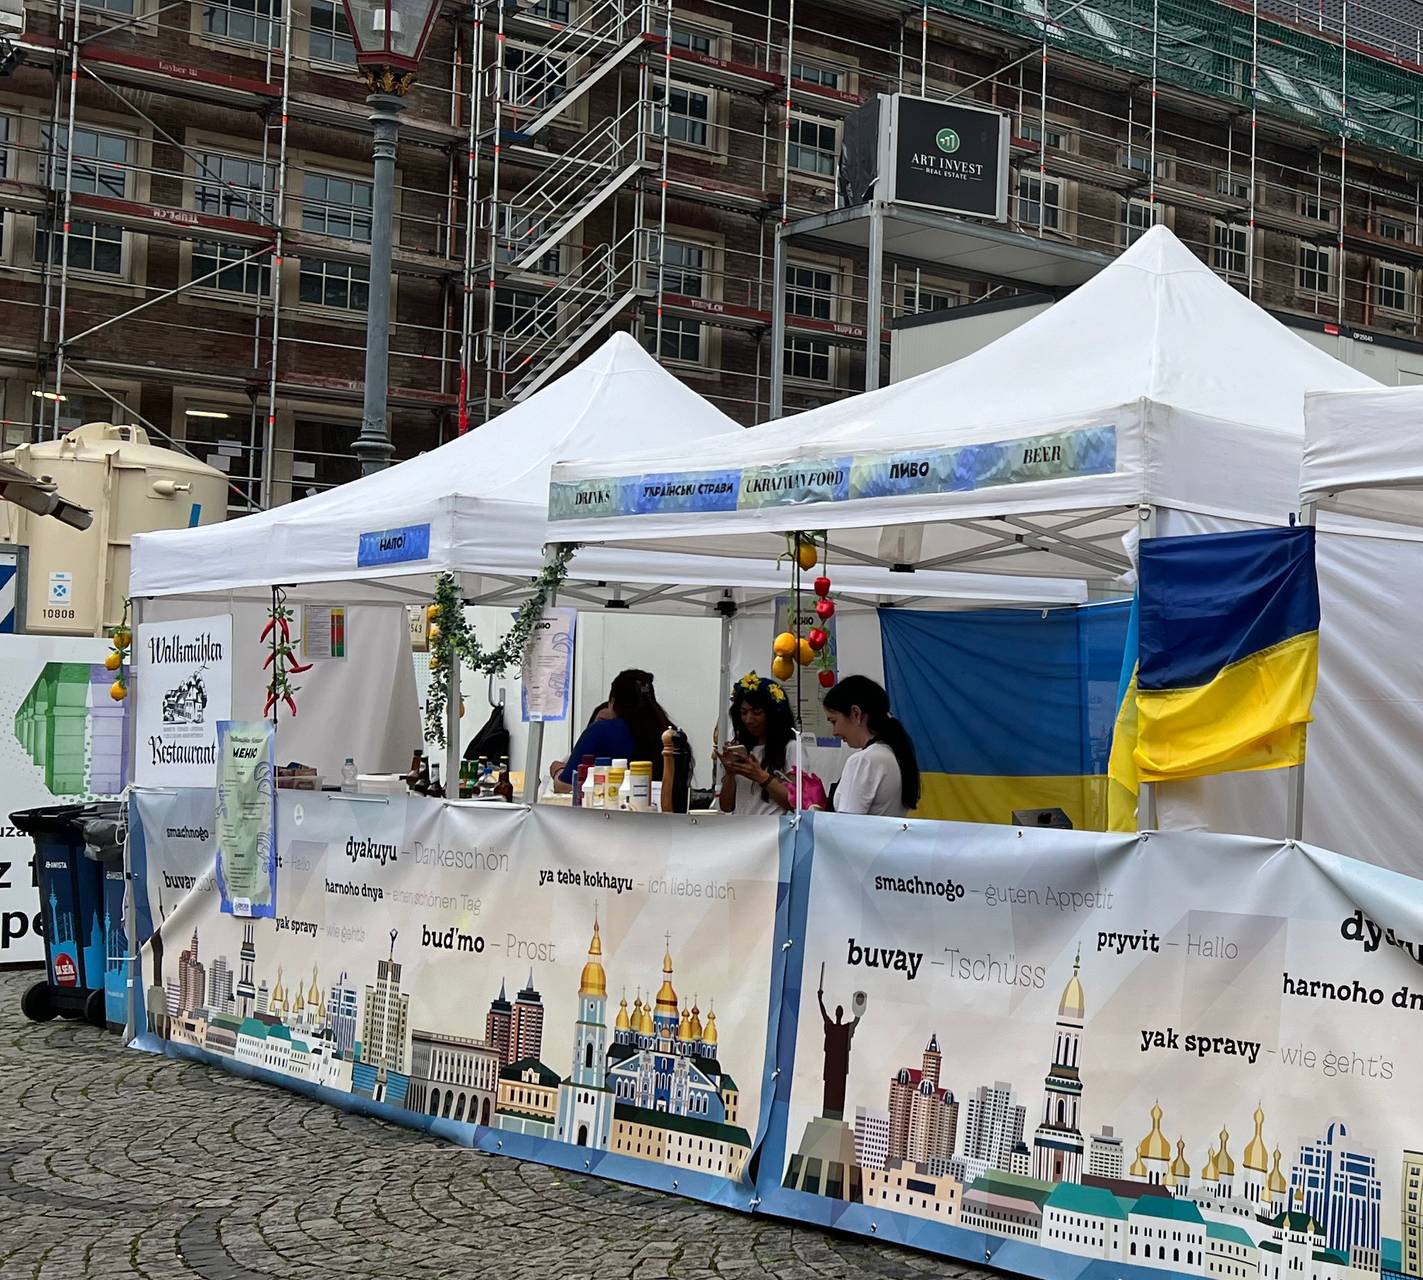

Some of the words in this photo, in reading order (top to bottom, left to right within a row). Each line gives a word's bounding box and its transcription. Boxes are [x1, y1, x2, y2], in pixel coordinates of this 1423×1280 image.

[911, 153, 936, 167] ART
[940, 157, 984, 176] INVEST
[925, 167, 942, 177] REAL
[944, 170, 968, 181] ESTATE
[1023, 445, 1062, 465] BEER
[807, 469, 844, 489] FOOD
[574, 489, 611, 506] DRINKS
[42, 608, 75, 619] 10808
[408, 623, 423, 634] 543
[147, 735, 216, 766] Restaurant
[166, 825, 210, 842] smachnogo
[345, 836, 398, 866] dyakuyu
[414, 841, 510, 873] Dankeschön
[324, 878, 361, 899] harnoho
[361, 883, 384, 902] dnya
[460, 893, 482, 916] Tag
[538, 868, 554, 887] ya
[557, 868, 582, 886] tebe
[583, 869, 634, 895] kokhayu
[647, 875, 668, 896] ich
[669, 875, 702, 898] liebe
[705, 878, 737, 901] dich
[874, 874, 965, 902] smachnogo
[984, 883, 1039, 908] guten
[1045, 884, 1114, 912] Appetit
[275, 916, 290, 933] yak
[291, 919, 319, 938] spravy
[421, 925, 486, 954] bud'mo
[505, 932, 557, 964] Prost
[1097, 928, 1160, 955] pryvit
[1186, 933, 1239, 961] Hallo
[847, 937, 923, 981] buvay
[944, 945, 1047, 990] Tschüss
[1282, 972, 1384, 1006] harnoho
[1140, 1027, 1180, 1052] yak
[1184, 1033, 1261, 1064] spravy
[1280, 1044, 1317, 1069] wie
[1322, 1047, 1395, 1081] geht's
